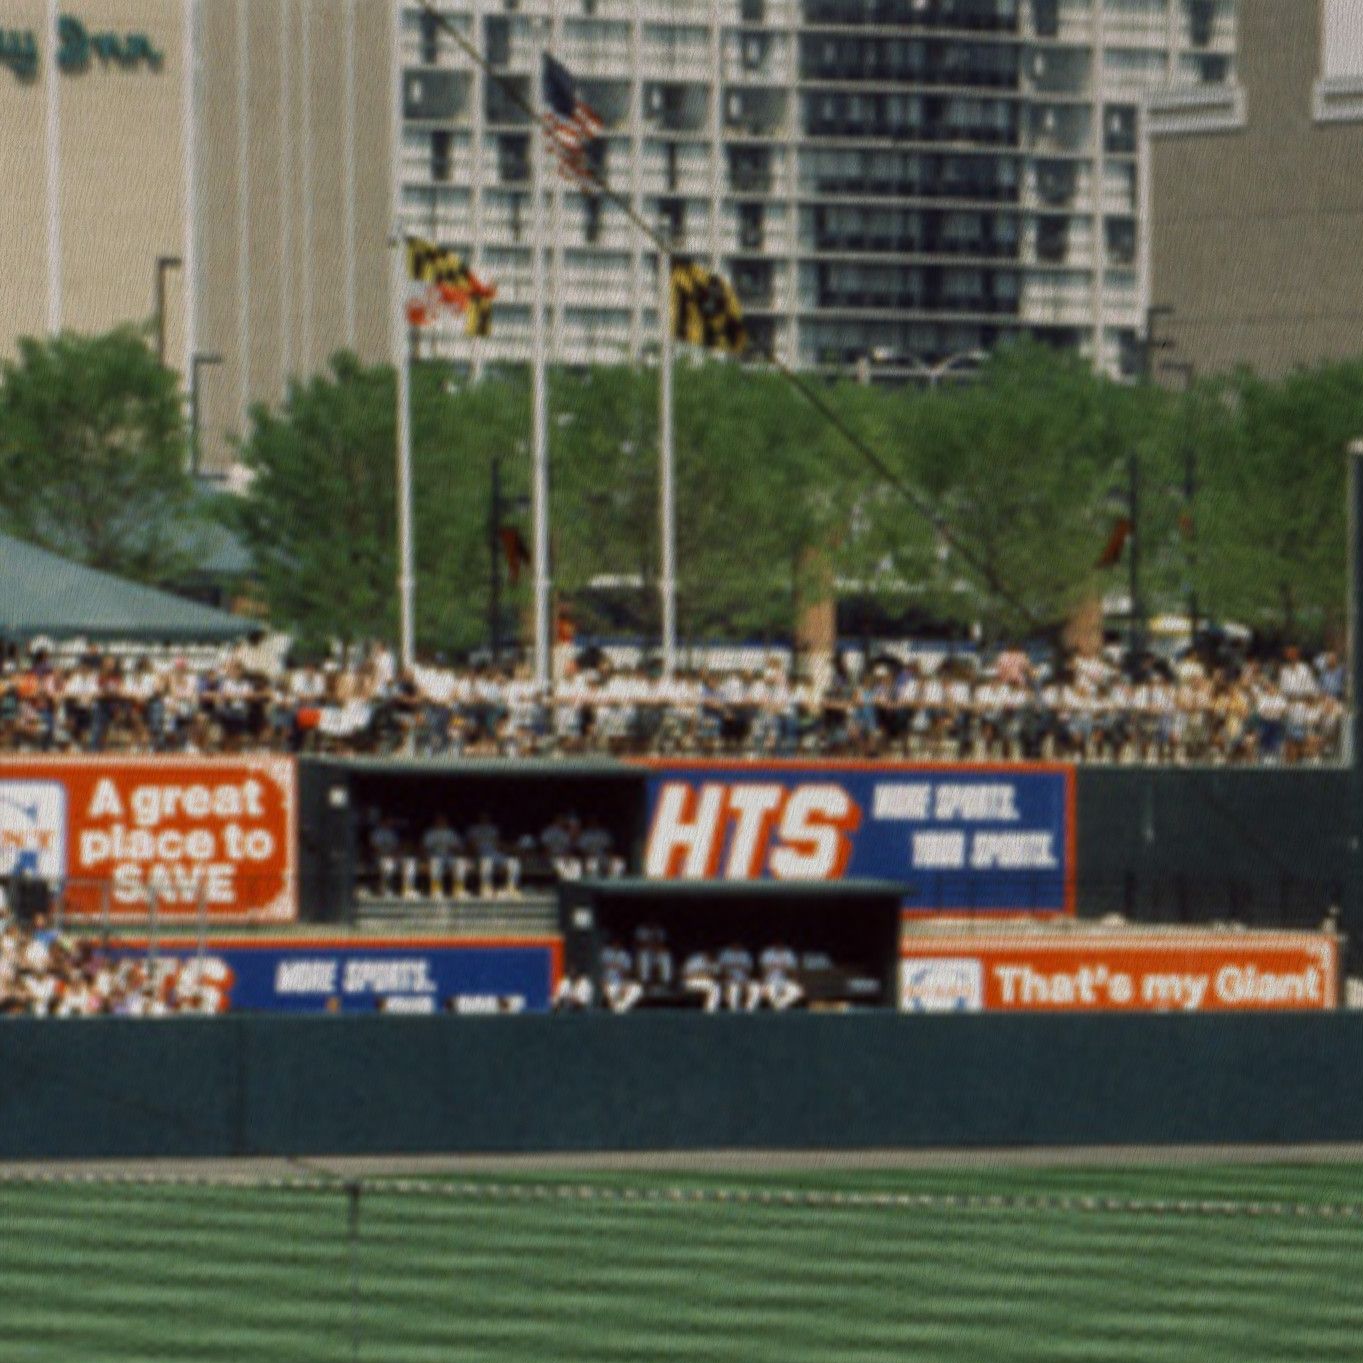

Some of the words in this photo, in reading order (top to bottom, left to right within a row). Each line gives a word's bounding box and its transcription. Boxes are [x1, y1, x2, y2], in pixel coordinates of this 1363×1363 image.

[88, 777, 124, 818] A
[131, 778, 264, 827] great
[79, 822, 216, 868] place
[223, 823, 274, 860] to
[645, 783, 862, 880] HTS
[112, 862, 236, 903] SAVE
[993, 962, 1133, 1002] That's
[1141, 971, 1208, 1011] my
[1213, 965, 1325, 1002] Giant
